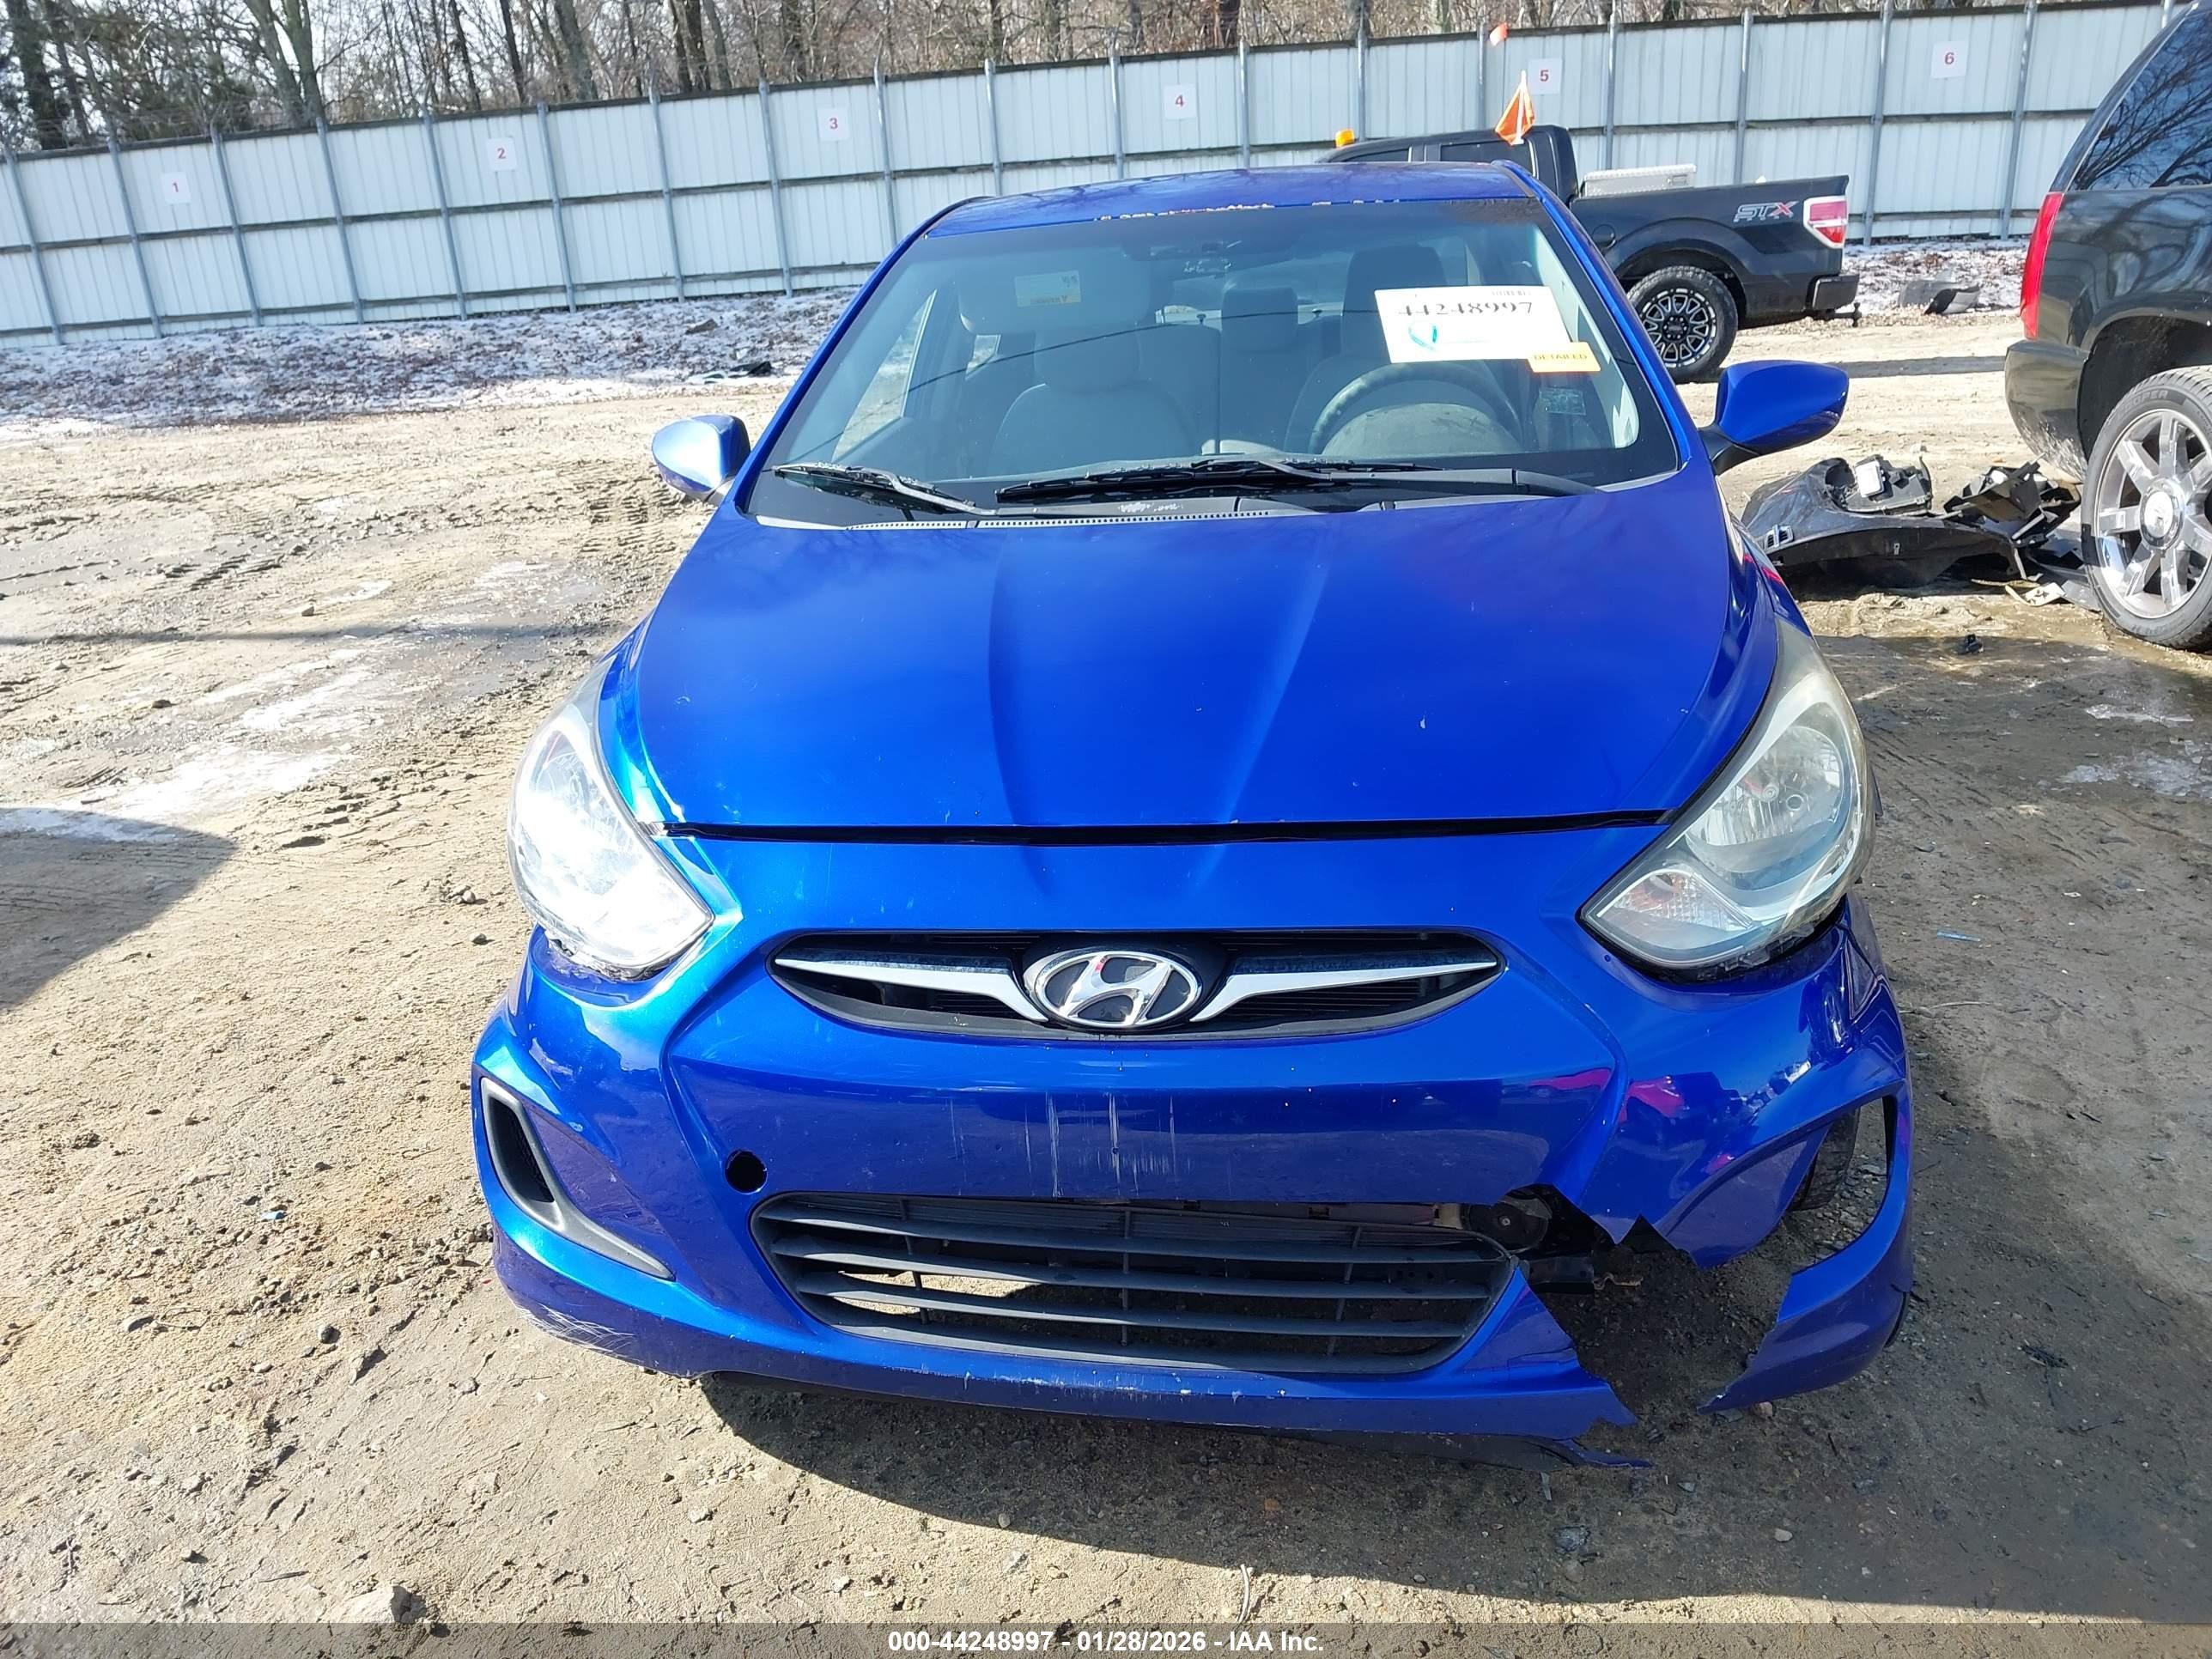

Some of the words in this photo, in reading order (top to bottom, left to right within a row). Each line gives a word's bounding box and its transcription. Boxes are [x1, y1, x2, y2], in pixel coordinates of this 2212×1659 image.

[1944, 51, 1955, 65] 6
[1540, 69, 1550, 82] 5
[1175, 95, 1186, 108] 4
[829, 117, 839, 131] 3
[496, 147, 507, 160] 2
[172, 181, 179, 193] 1
[1735, 200, 1799, 218] STX
